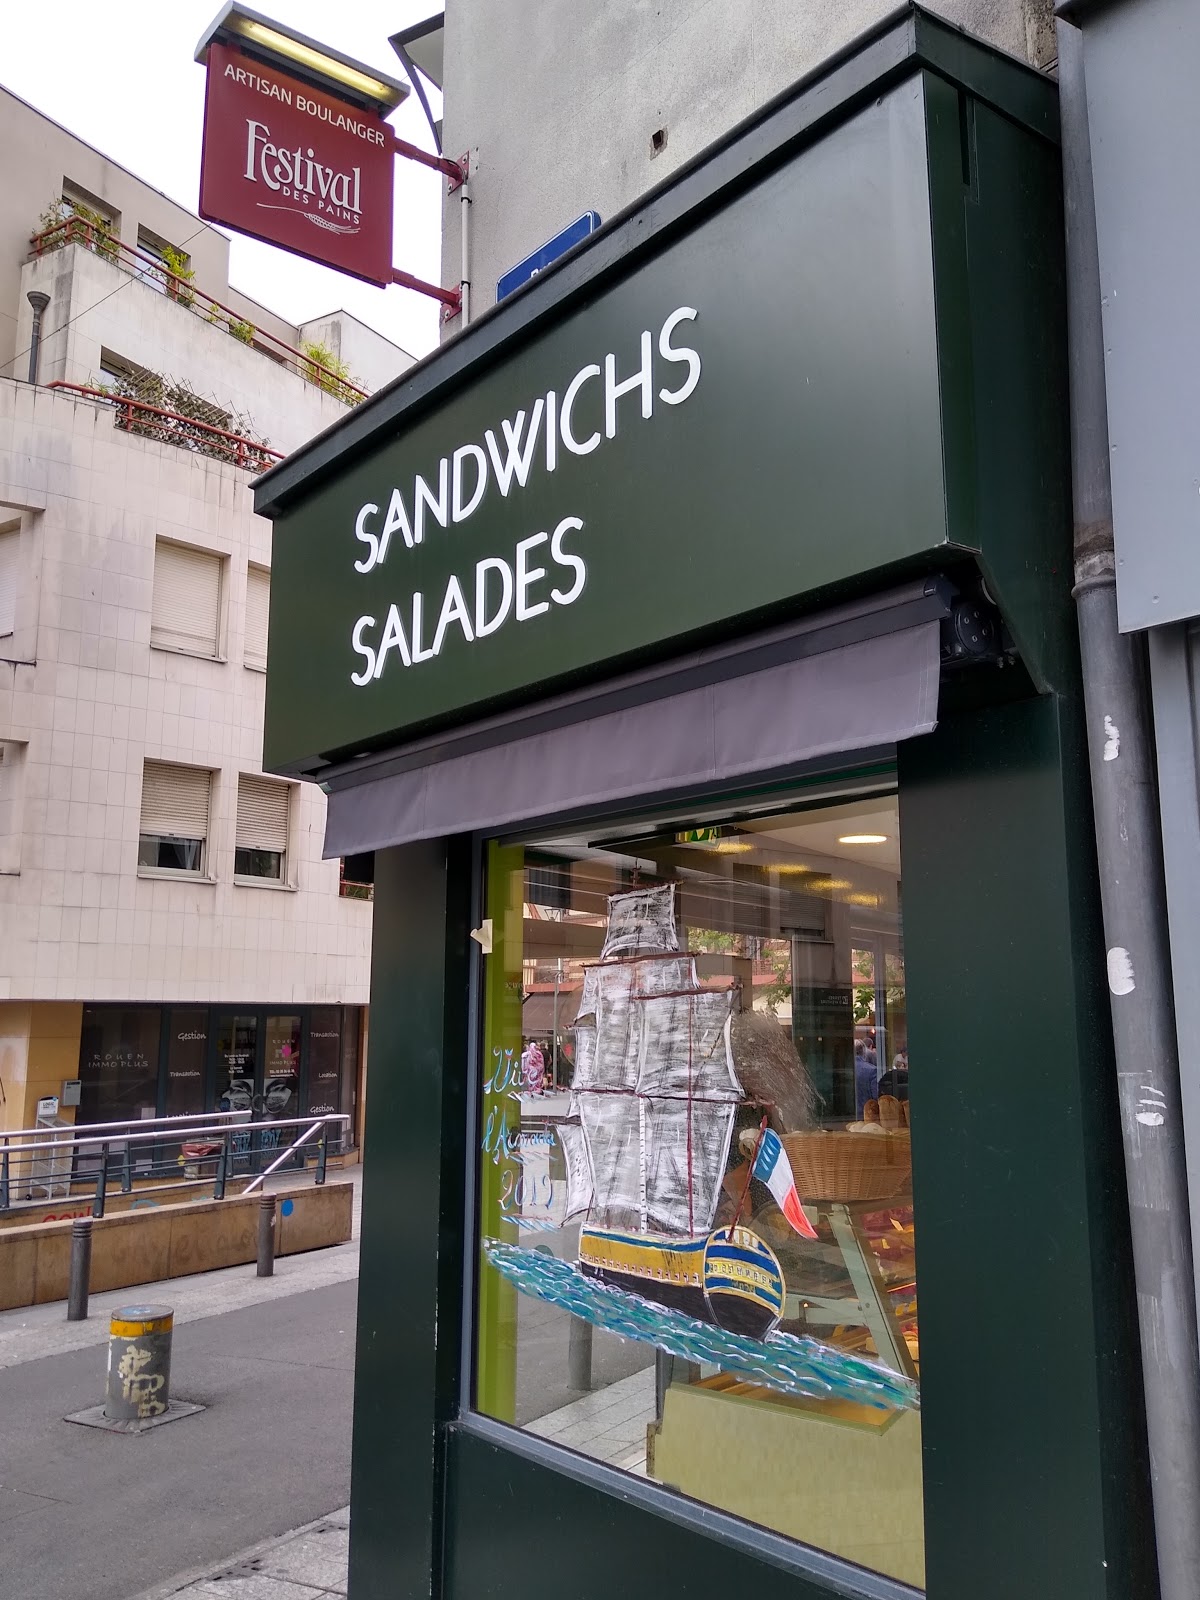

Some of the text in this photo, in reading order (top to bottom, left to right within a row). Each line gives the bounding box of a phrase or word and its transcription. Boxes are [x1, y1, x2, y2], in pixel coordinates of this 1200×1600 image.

[224, 63, 385, 148] ARTISAN BOULANGER
[243, 118, 363, 215] Festival
[283, 185, 360, 225] DES PAINS
[353, 306, 702, 574] SANDWICHS
[350, 516, 587, 687] SALADES
[177, 1030, 207, 1041] Gestion
[93, 1053, 145, 1061] ROUEN
[120, 1060, 149, 1068] PLUS
[169, 1069, 201, 1078] Transaction
[483, 1045, 539, 1094] Vive
[309, 1103, 335, 1115] Gestion
